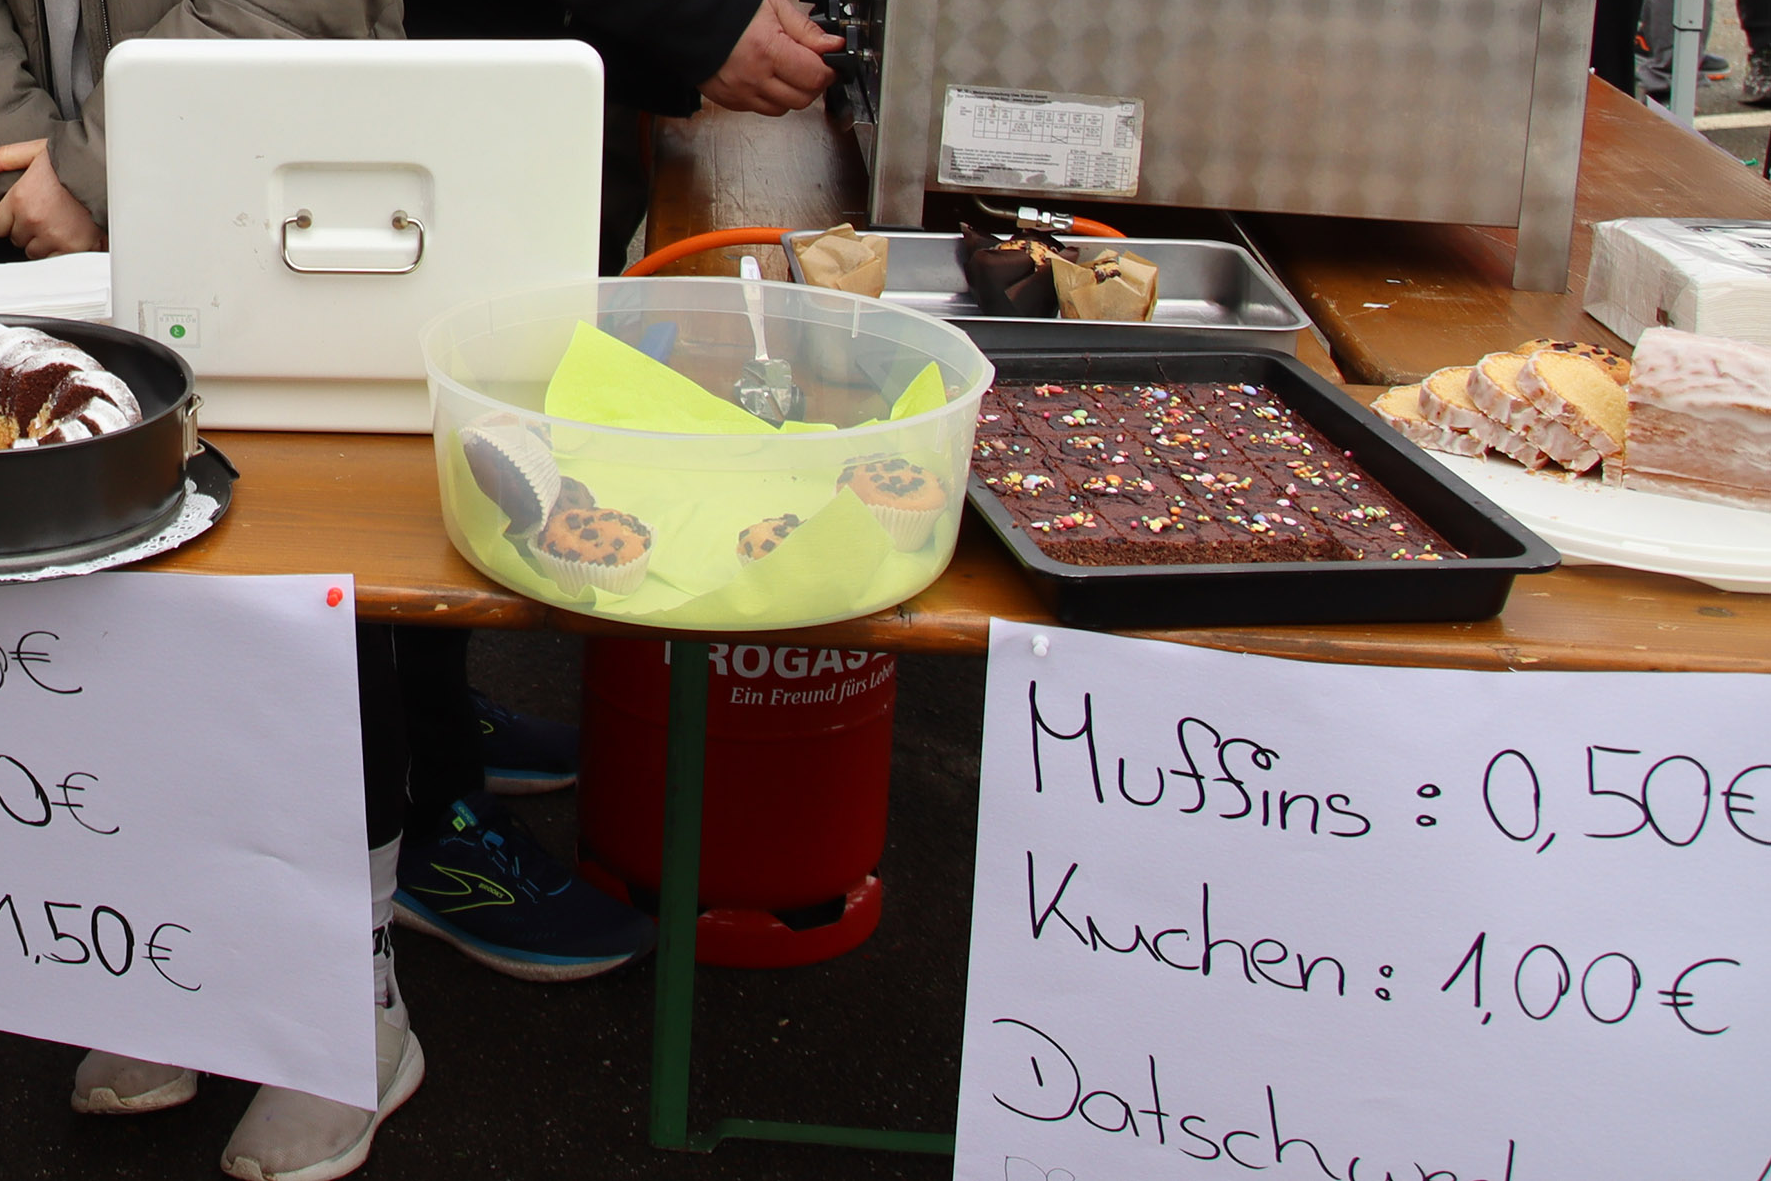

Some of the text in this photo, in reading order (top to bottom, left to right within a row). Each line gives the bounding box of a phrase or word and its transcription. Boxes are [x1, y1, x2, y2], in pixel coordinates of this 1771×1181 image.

[730, 686, 764, 705] Ein
[769, 683, 836, 706] Freund
[837, 678, 868, 705] fürs
[1441, 932, 1741, 1036] 1,00€
